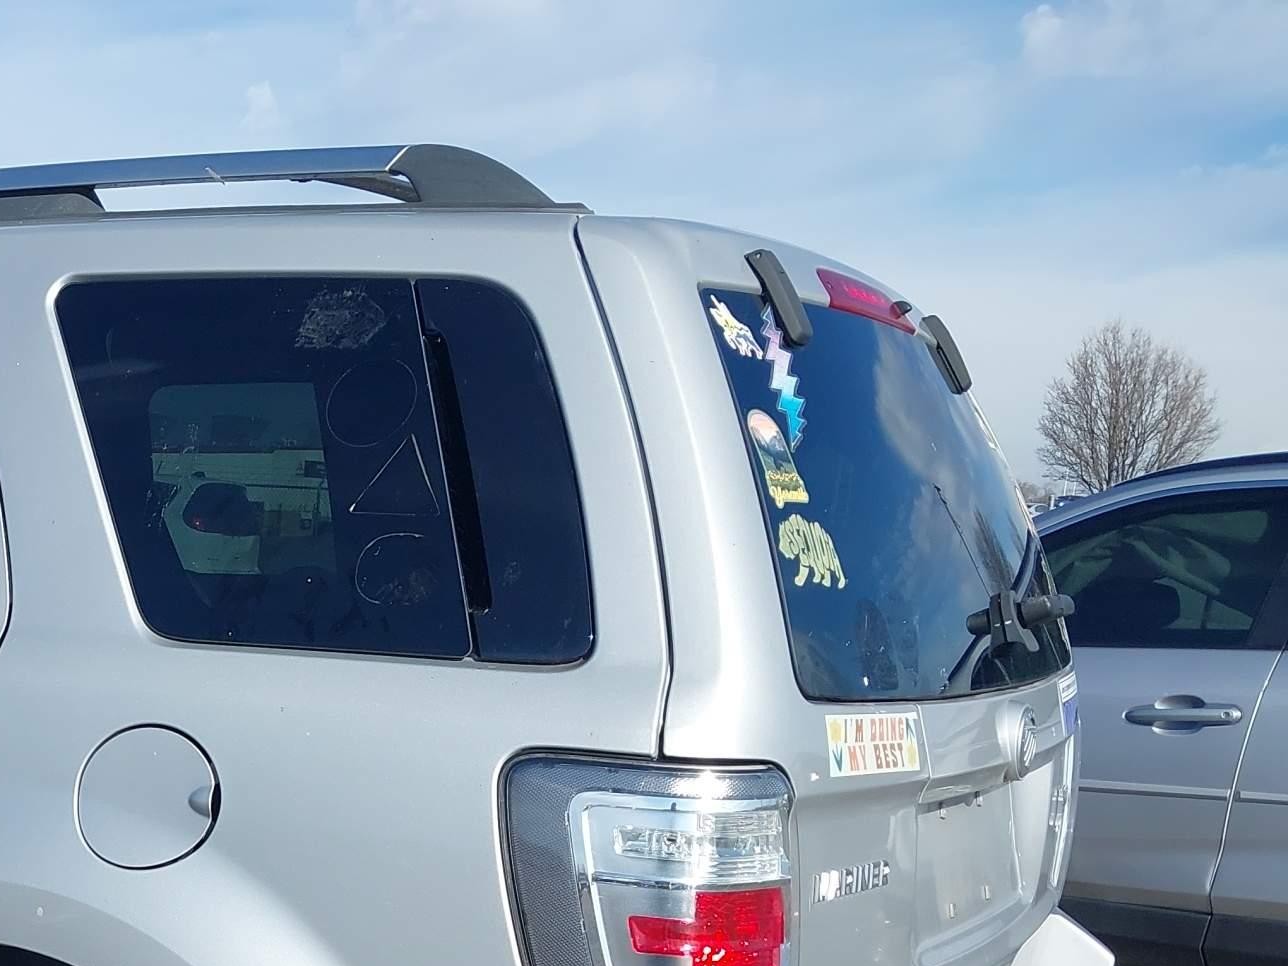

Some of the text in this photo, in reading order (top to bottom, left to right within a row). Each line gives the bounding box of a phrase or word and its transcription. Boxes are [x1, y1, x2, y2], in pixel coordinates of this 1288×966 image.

[844, 716, 905, 743] I'M DOING
[848, 742, 905, 771] MY BEST
[812, 859, 890, 904] MARINER
